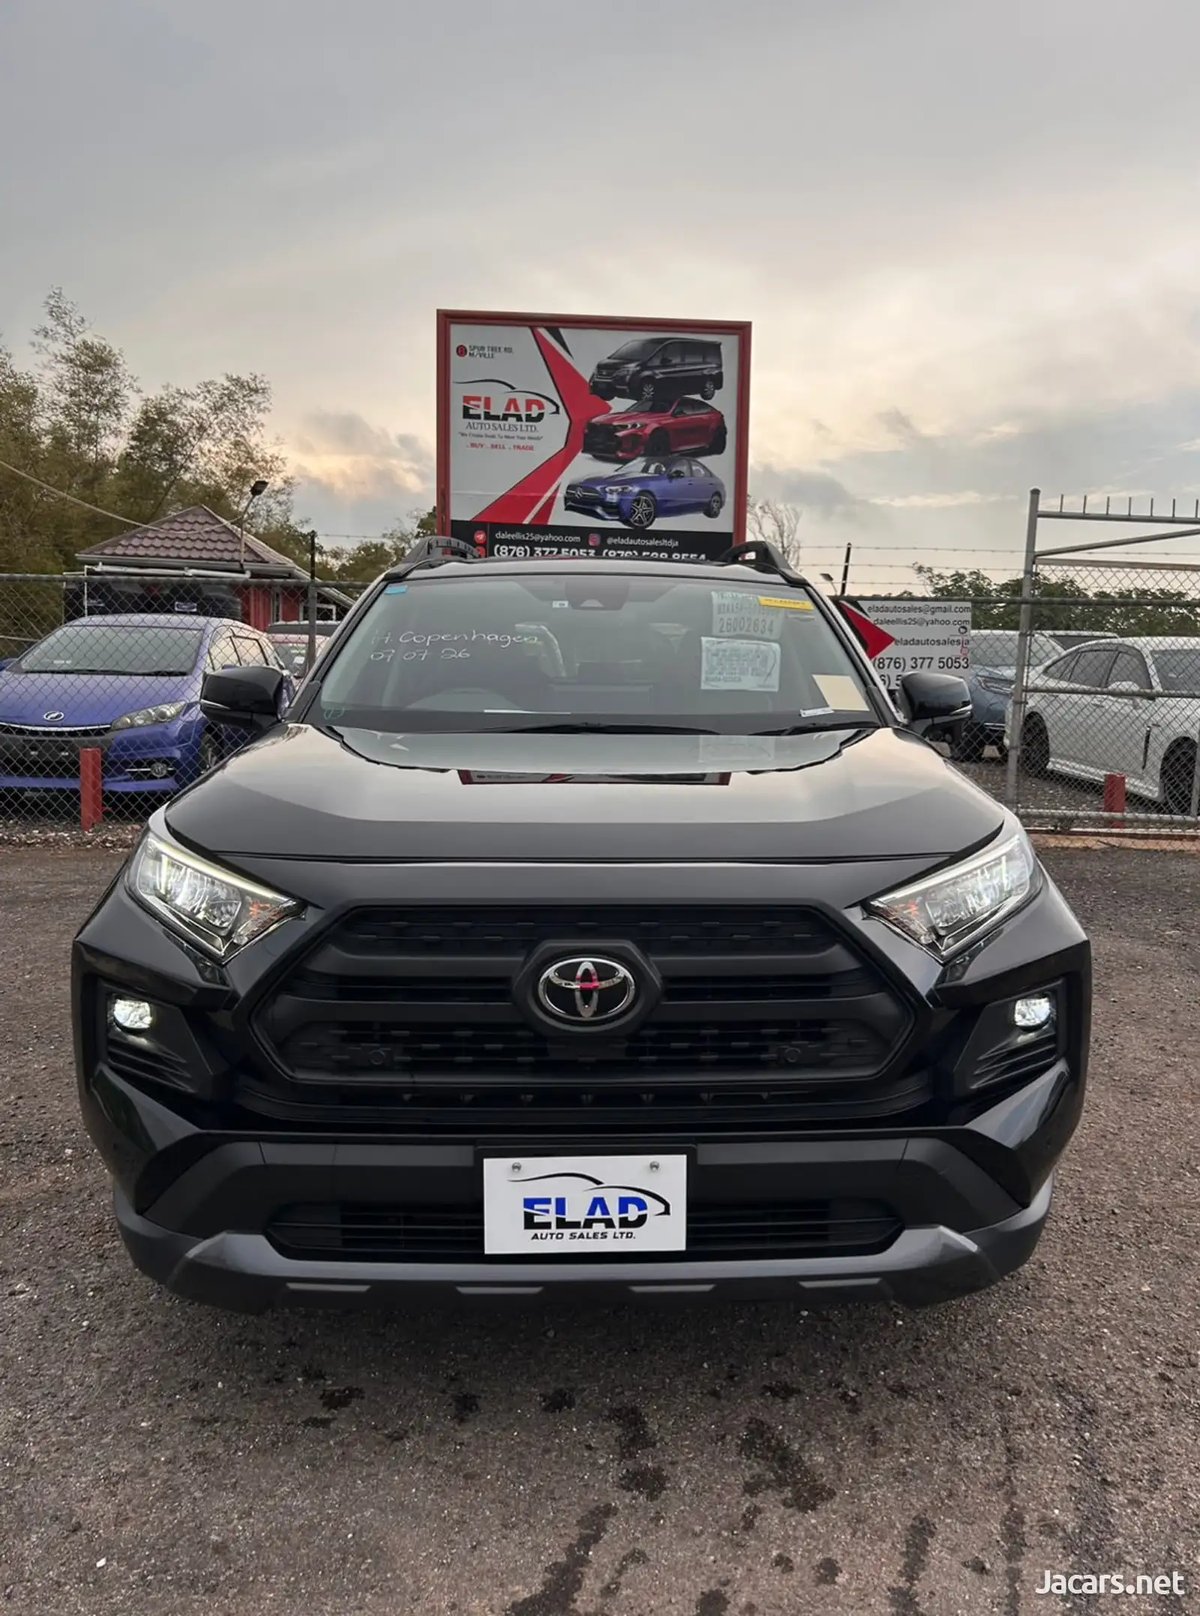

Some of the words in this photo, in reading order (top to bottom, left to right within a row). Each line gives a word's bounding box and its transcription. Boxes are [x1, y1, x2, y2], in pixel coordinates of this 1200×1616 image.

[462, 395, 545, 423] ELAD
[465, 421, 491, 431] AUTO
[491, 422, 519, 432] SALES
[519, 423, 539, 433] LTD.
[495, 531, 581, 543] daleellis25@yahoo.com
[493, 544, 530, 557] (876)
[533, 547, 559, 557] 377
[868, 604, 971, 615] eladautosales@gmail.com
[874, 617, 970, 627] daleellis25@yahoo.com
[399, 629, 539, 648] Copenhagen
[440, 647, 471, 660] 26
[873, 656, 906, 672] (876)
[910, 656, 934, 670] 377
[937, 656, 970, 670] 5053
[523, 1196, 648, 1230] ELAD
[530, 1231, 564, 1240] AUTO
[568, 1231, 608, 1240] SALES
[612, 1231, 636, 1240] LTD.
